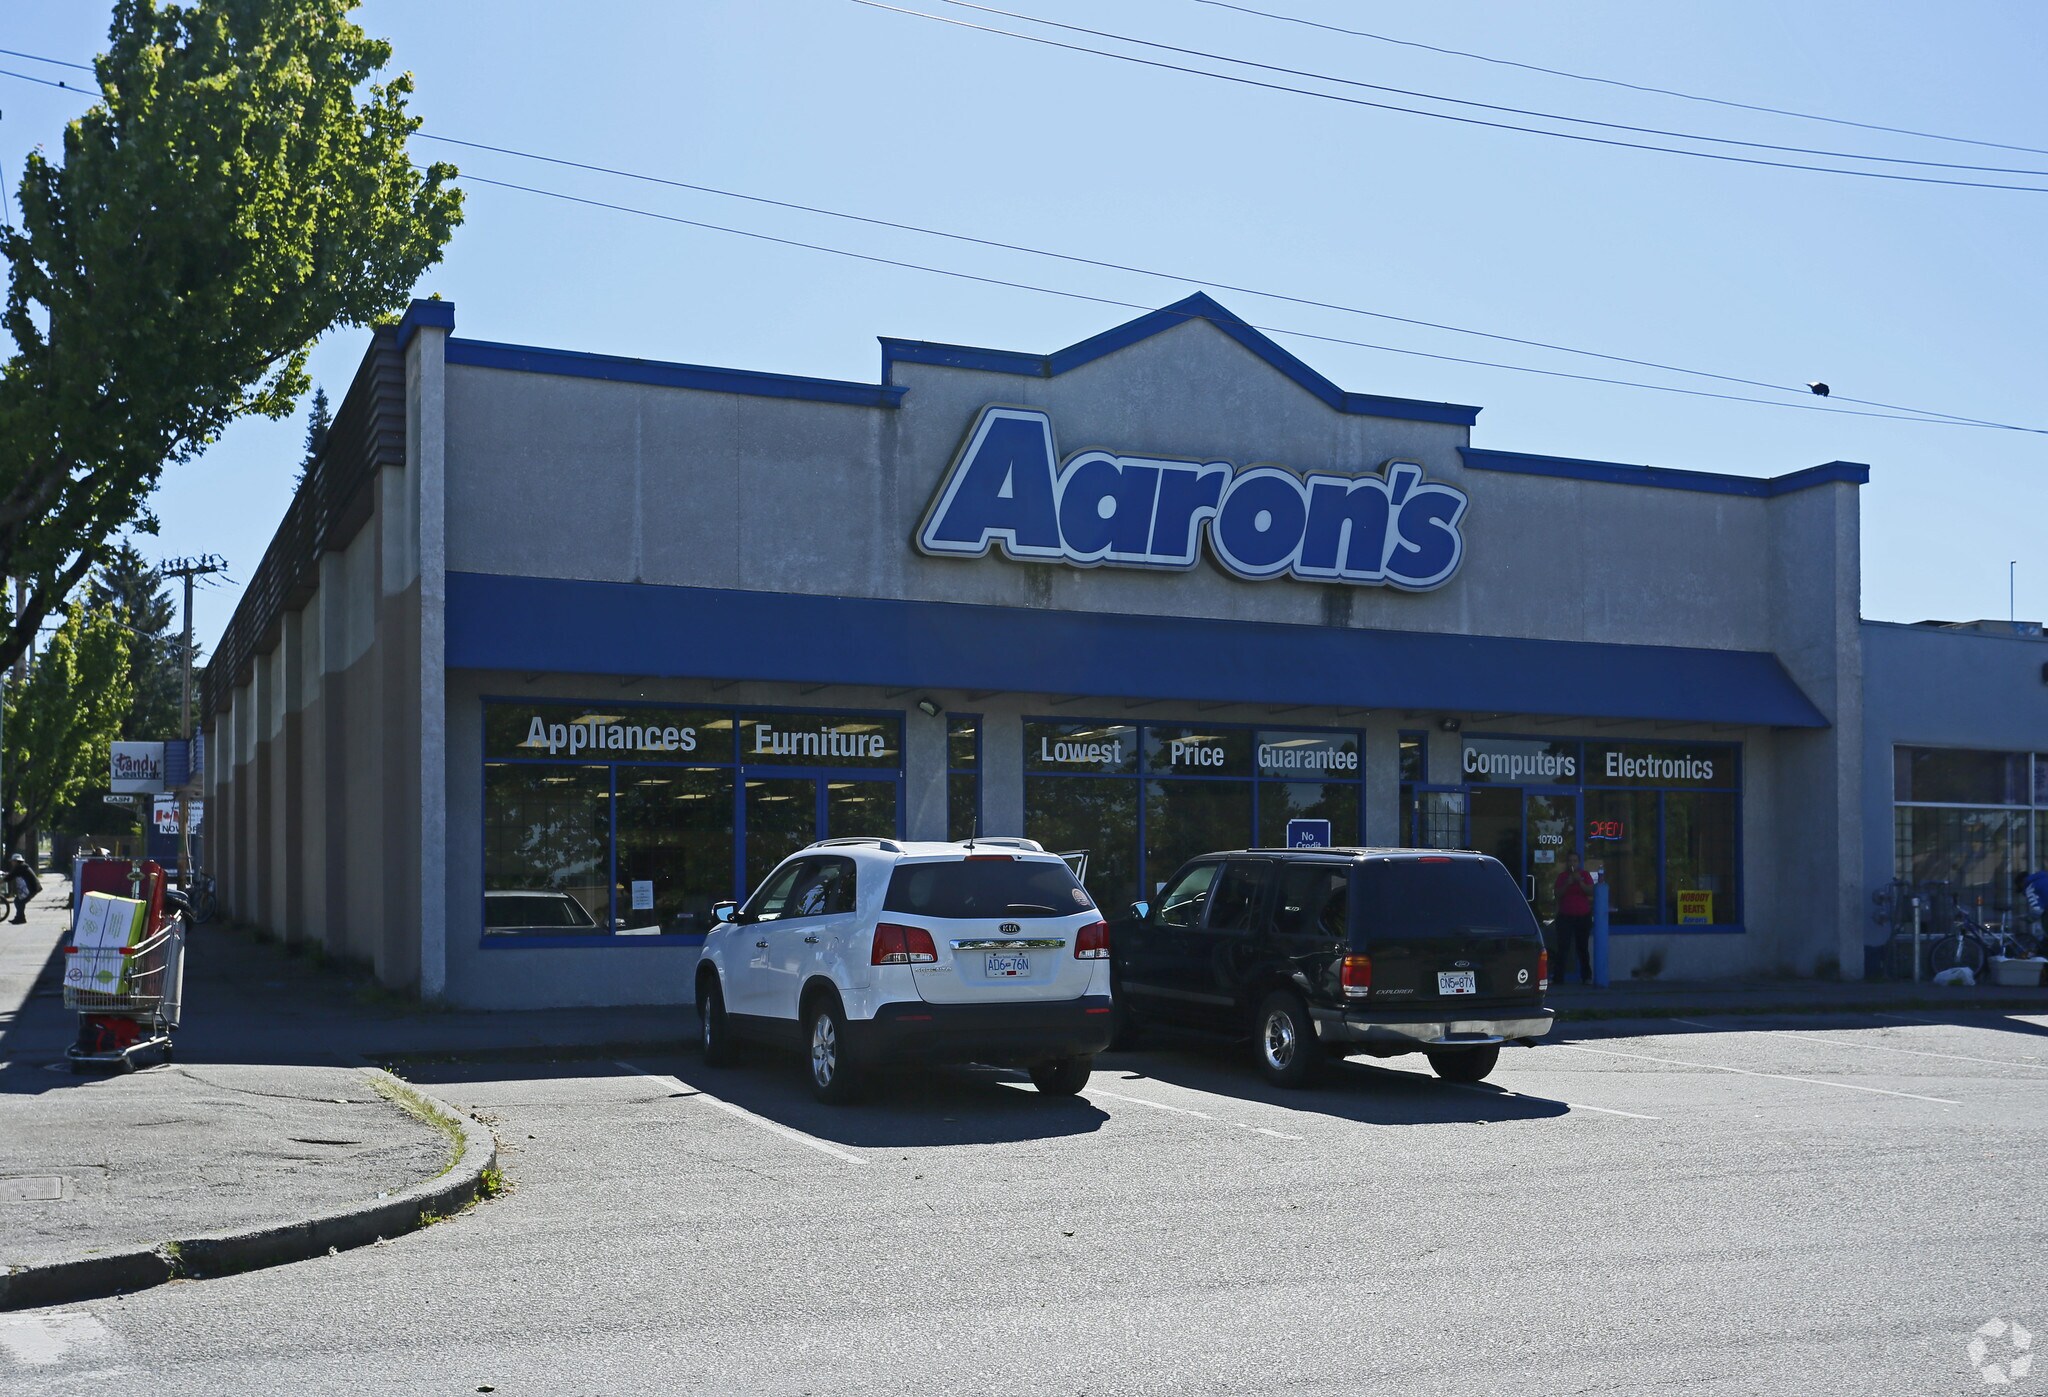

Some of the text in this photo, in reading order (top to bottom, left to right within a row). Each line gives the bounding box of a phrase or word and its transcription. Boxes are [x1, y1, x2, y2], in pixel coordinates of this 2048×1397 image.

[916, 404, 1468, 592] Aaron's
[526, 716, 885, 758] Appliances Furniture
[1041, 736, 1358, 770] Lowest Price Guarantee
[1463, 747, 1714, 780] Computers Electronics
[1301, 831, 1314, 841] No
[1538, 835, 1563, 845] 10790
[1296, 841, 1321, 849] Credit
[1682, 904, 1706, 914] BEATS
[1002, 924, 1018, 932] KIA
